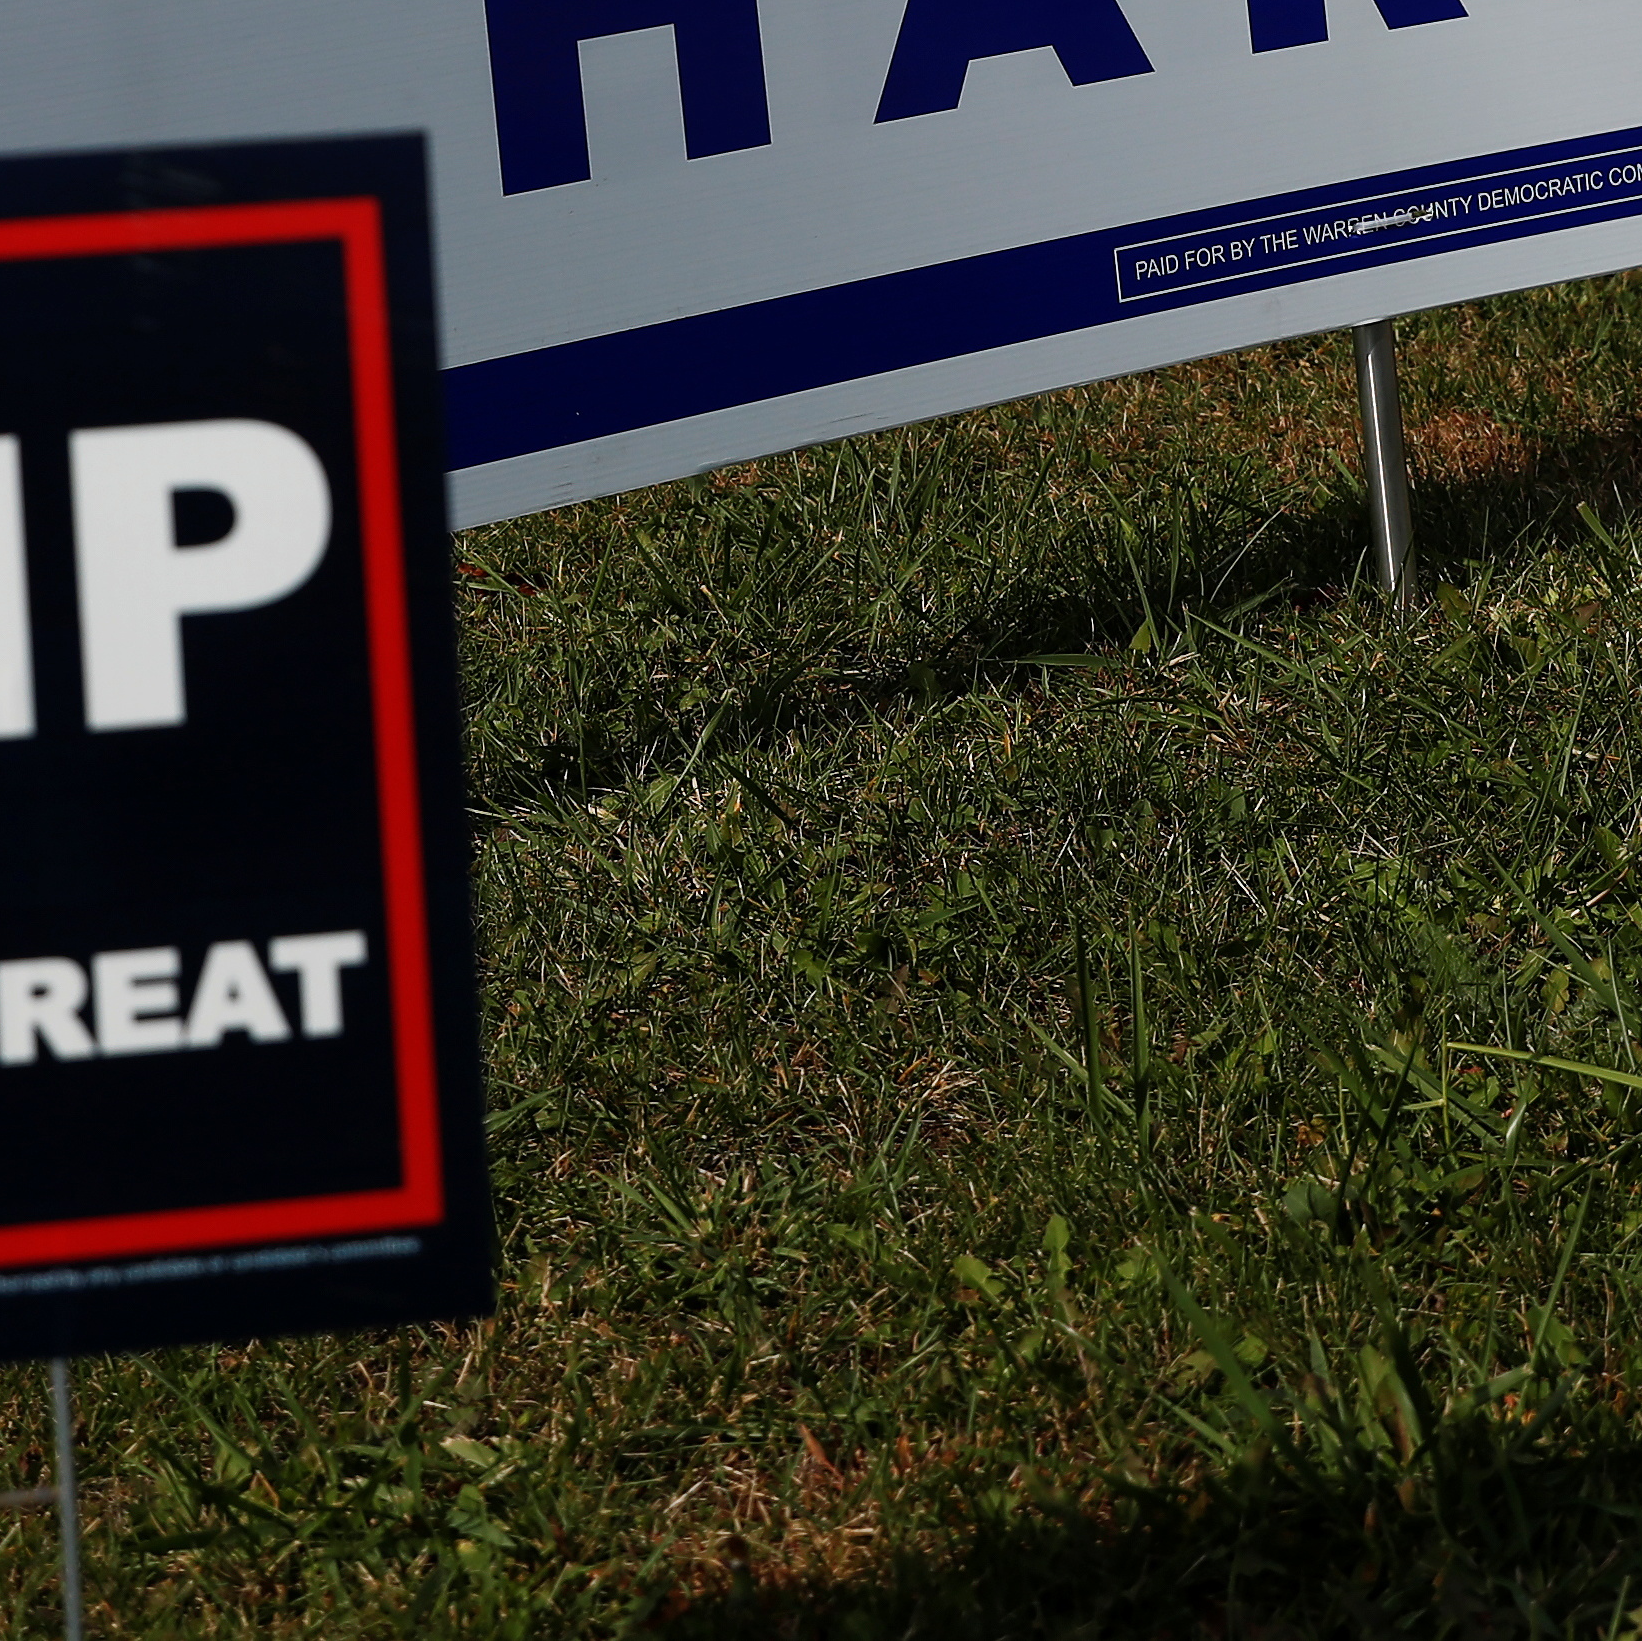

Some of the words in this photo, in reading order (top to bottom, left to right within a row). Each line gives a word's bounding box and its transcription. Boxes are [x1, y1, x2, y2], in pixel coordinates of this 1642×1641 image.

[1135, 253, 1179, 281] PAID
[1184, 243, 1227, 271] FOR
[1230, 237, 1256, 261] BY
[1259, 228, 1300, 255] THE
[1477, 170, 1604, 212] DEMOCRATIC
